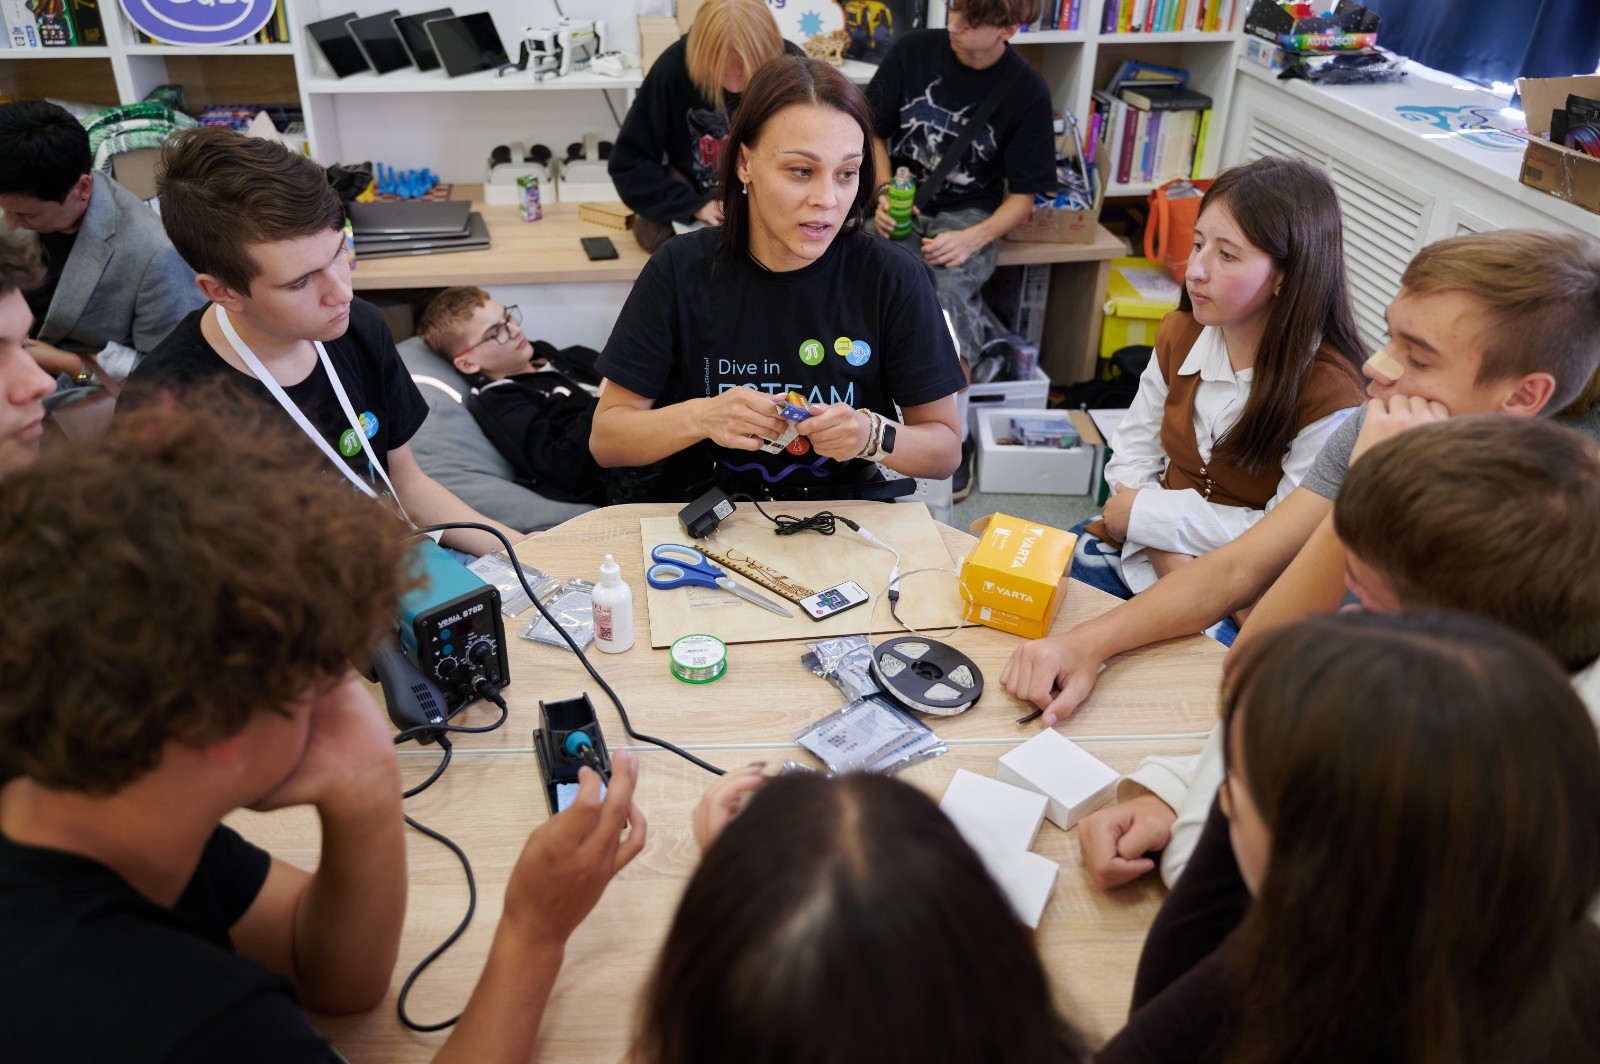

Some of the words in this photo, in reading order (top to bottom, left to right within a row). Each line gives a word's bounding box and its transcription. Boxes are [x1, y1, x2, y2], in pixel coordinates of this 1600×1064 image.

[718, 359, 758, 375] Dive
[764, 358, 780, 375] in
[1010, 537, 1035, 568] VARTA
[996, 586, 1034, 603] VARTA
[462, 603, 484, 617] 878D
